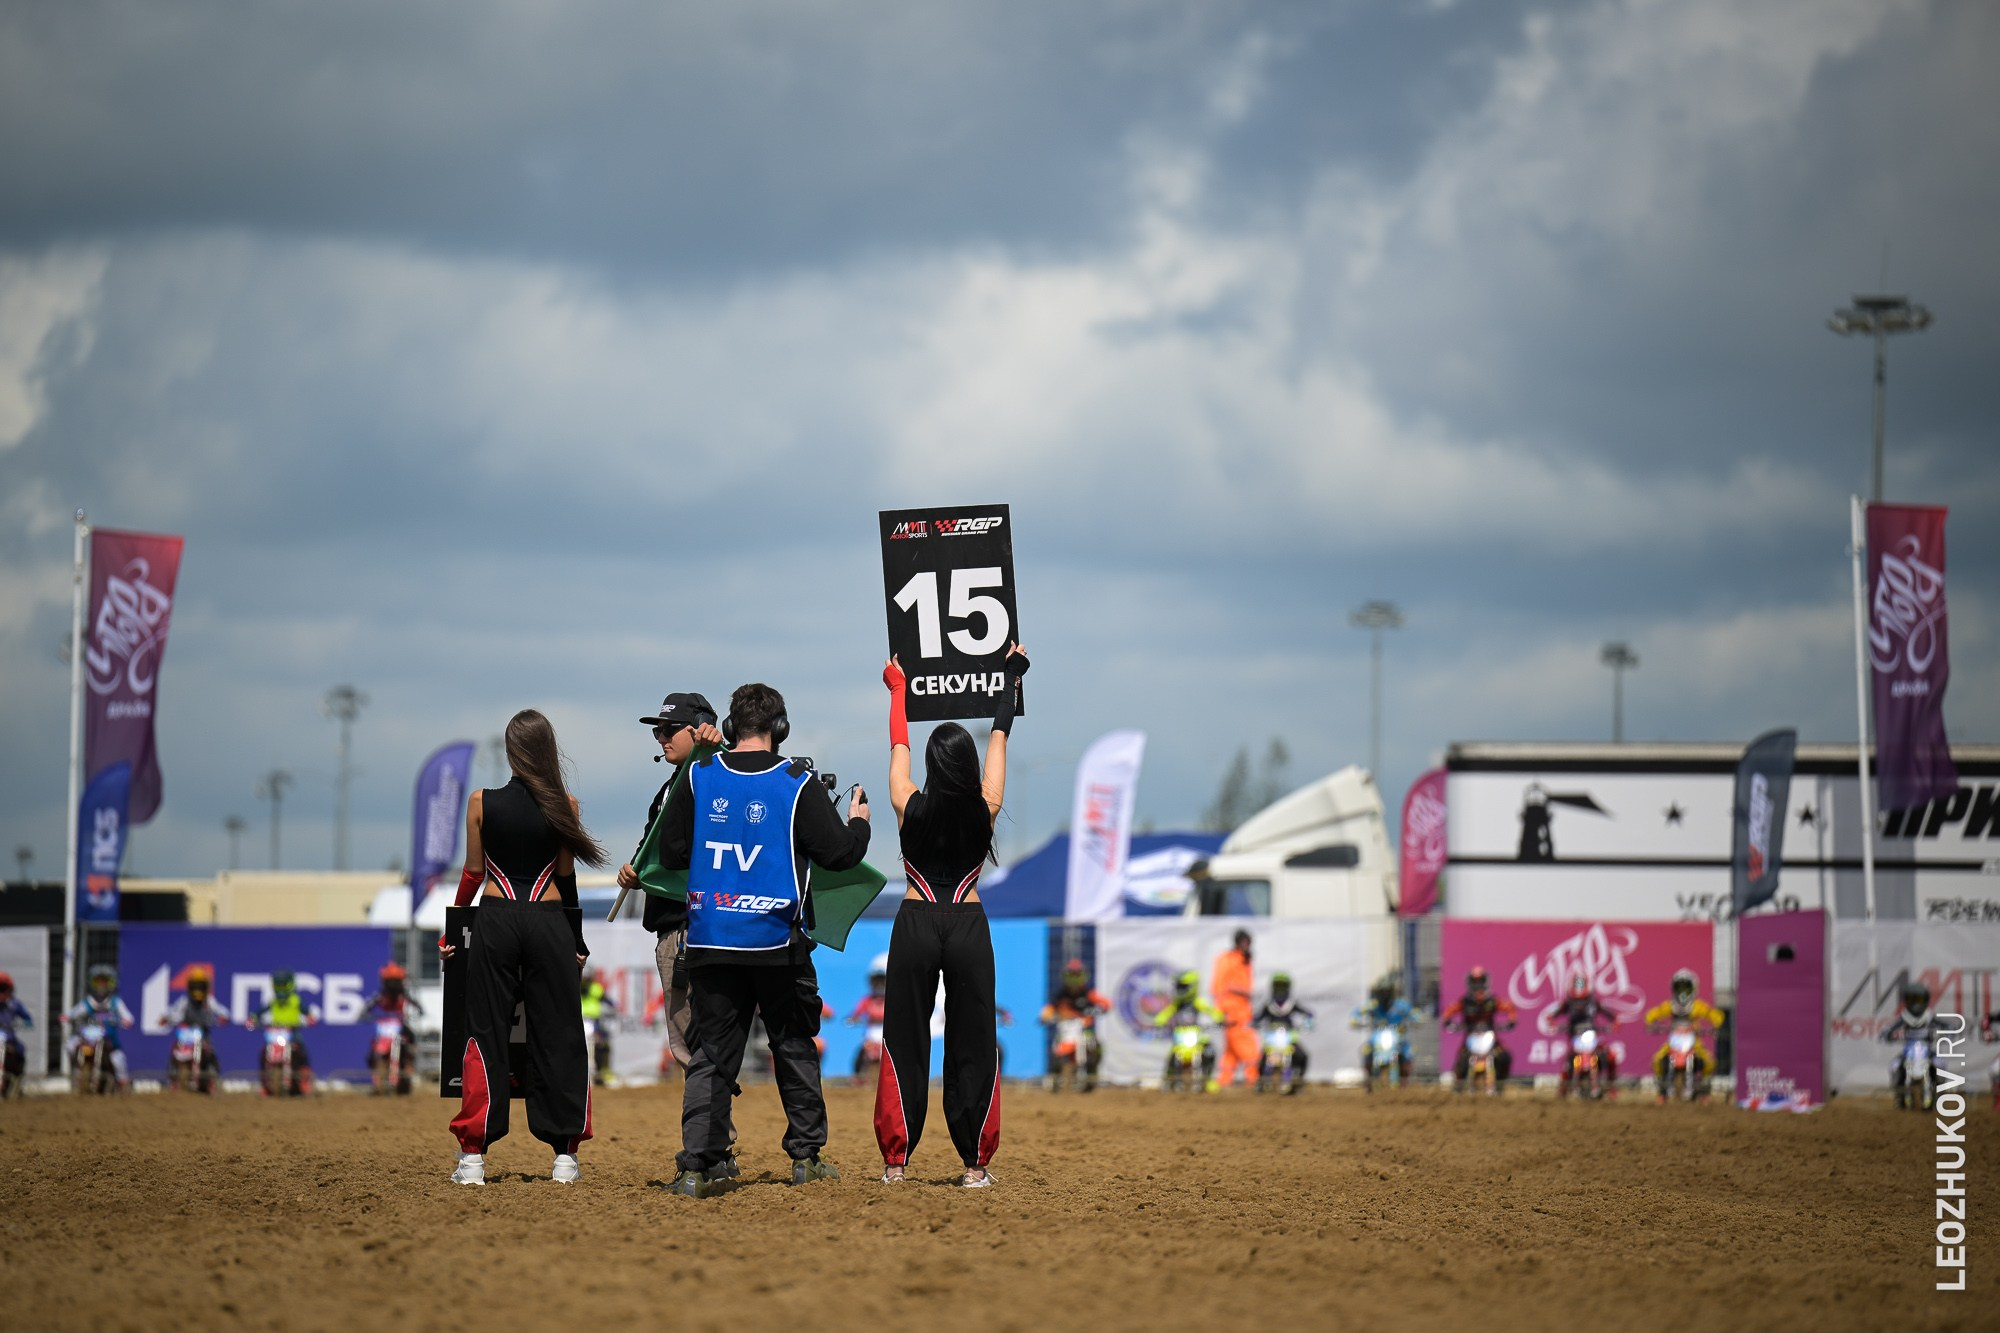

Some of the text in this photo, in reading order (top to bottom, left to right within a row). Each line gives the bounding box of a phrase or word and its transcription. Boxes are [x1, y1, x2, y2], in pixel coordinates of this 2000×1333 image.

[954, 517, 1003, 532] RGP
[893, 566, 1010, 659] 15
[910, 671, 1005, 697] СЕКУНД
[705, 841, 763, 871] TV
[732, 894, 791, 910] RGP
